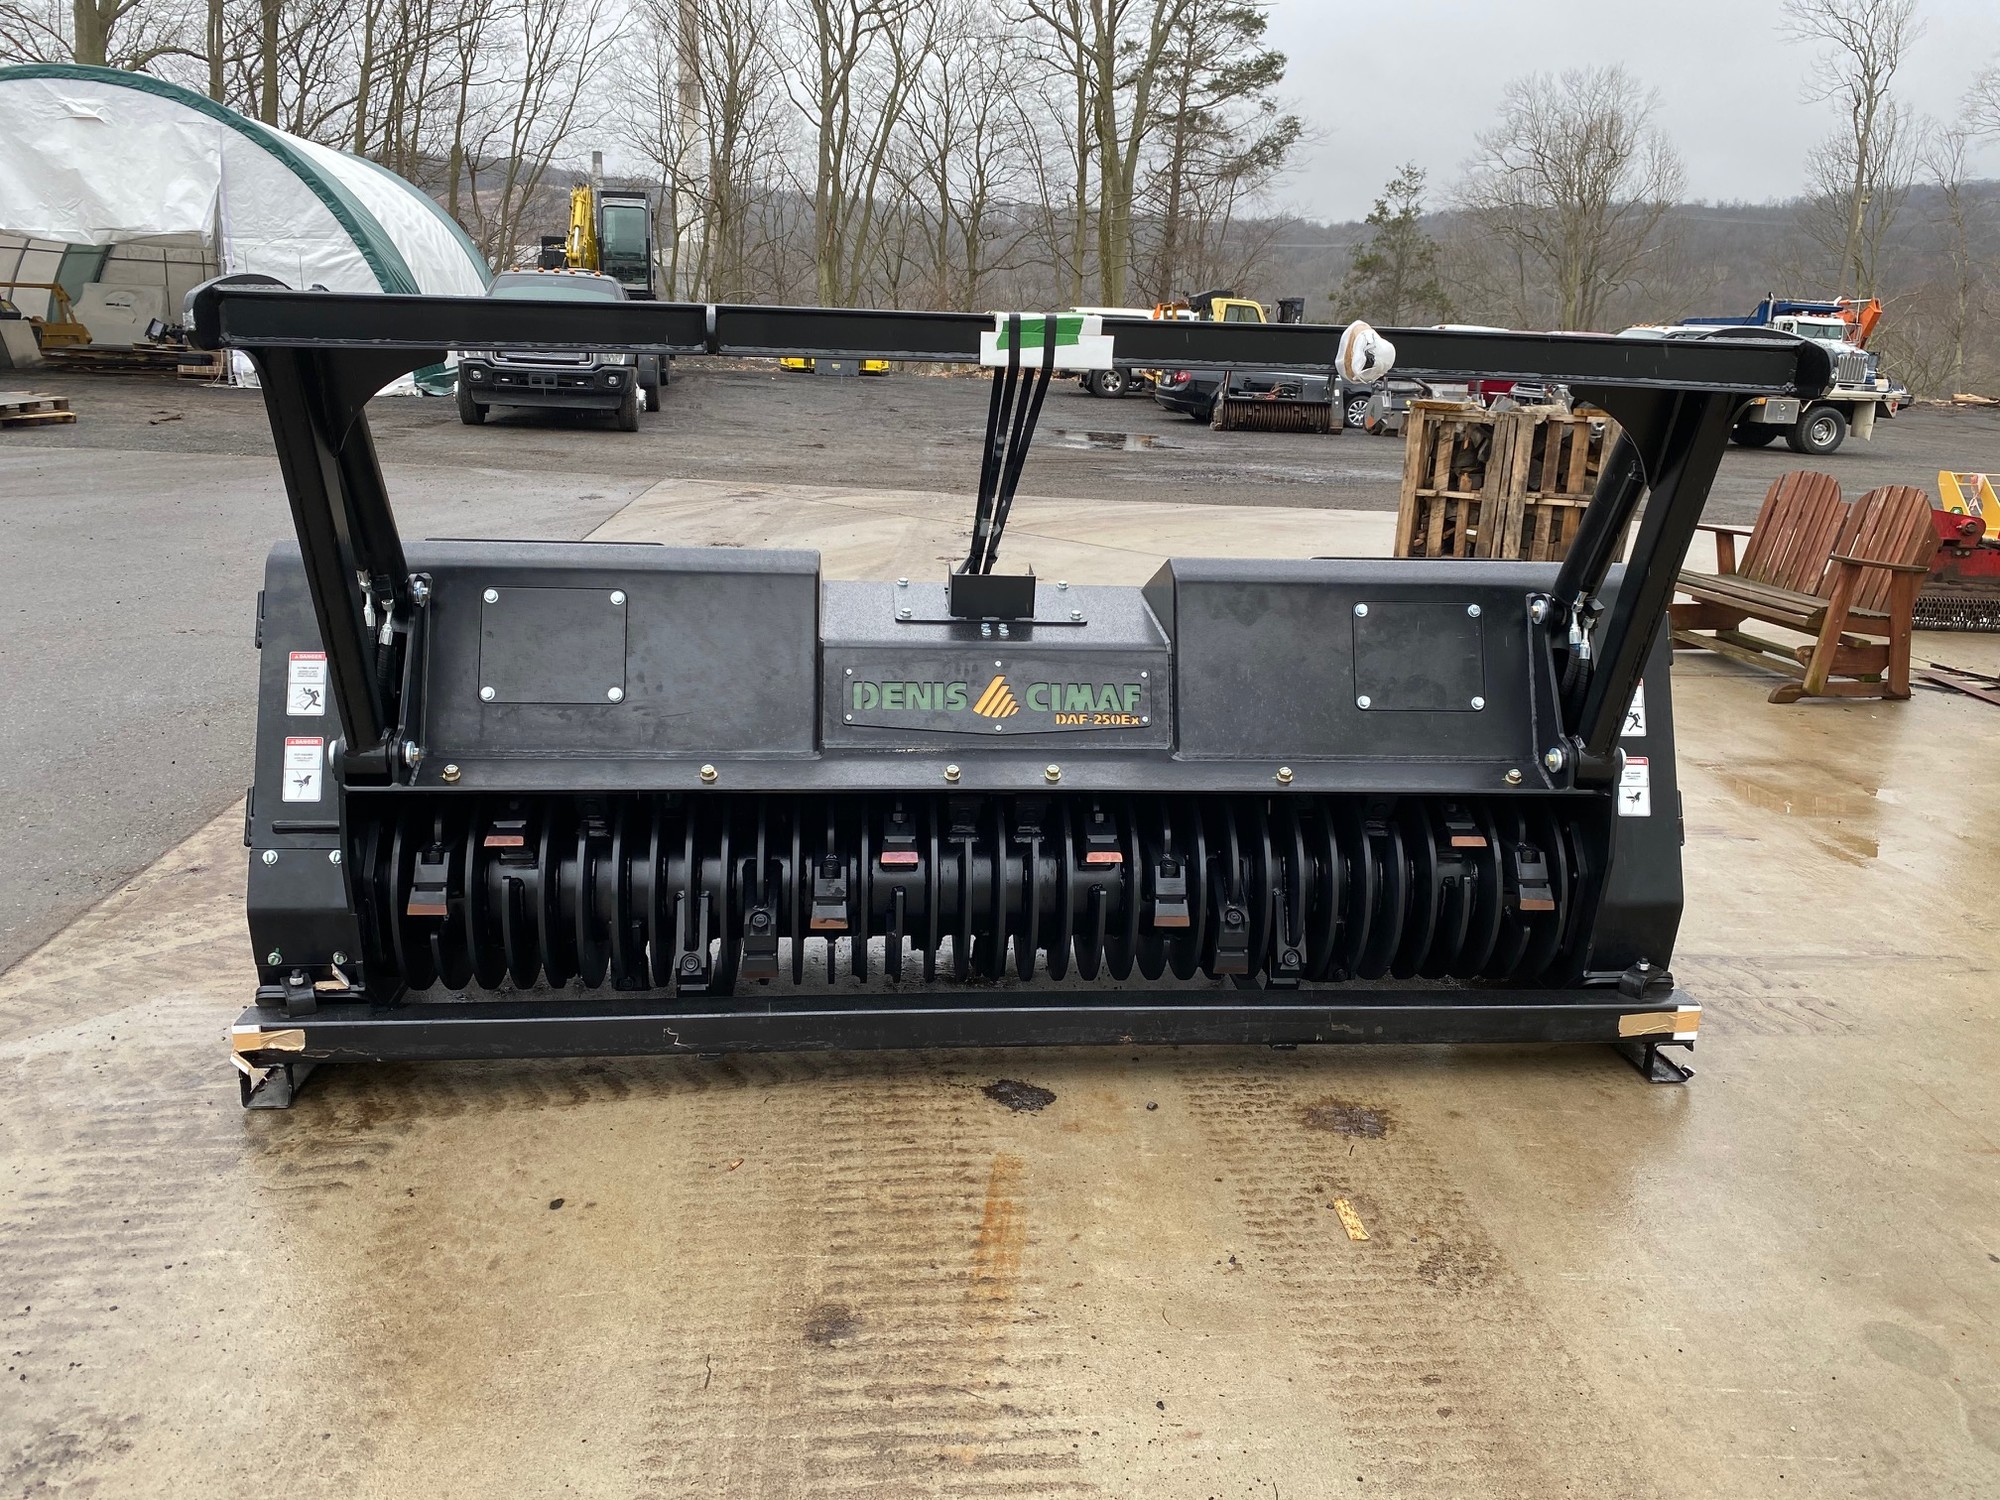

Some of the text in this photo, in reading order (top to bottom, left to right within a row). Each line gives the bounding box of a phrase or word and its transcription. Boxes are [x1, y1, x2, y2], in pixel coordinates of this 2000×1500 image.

[852, 681, 1142, 712] DENIS CIMAF
[1055, 713, 1140, 725] DAF-250Ex
